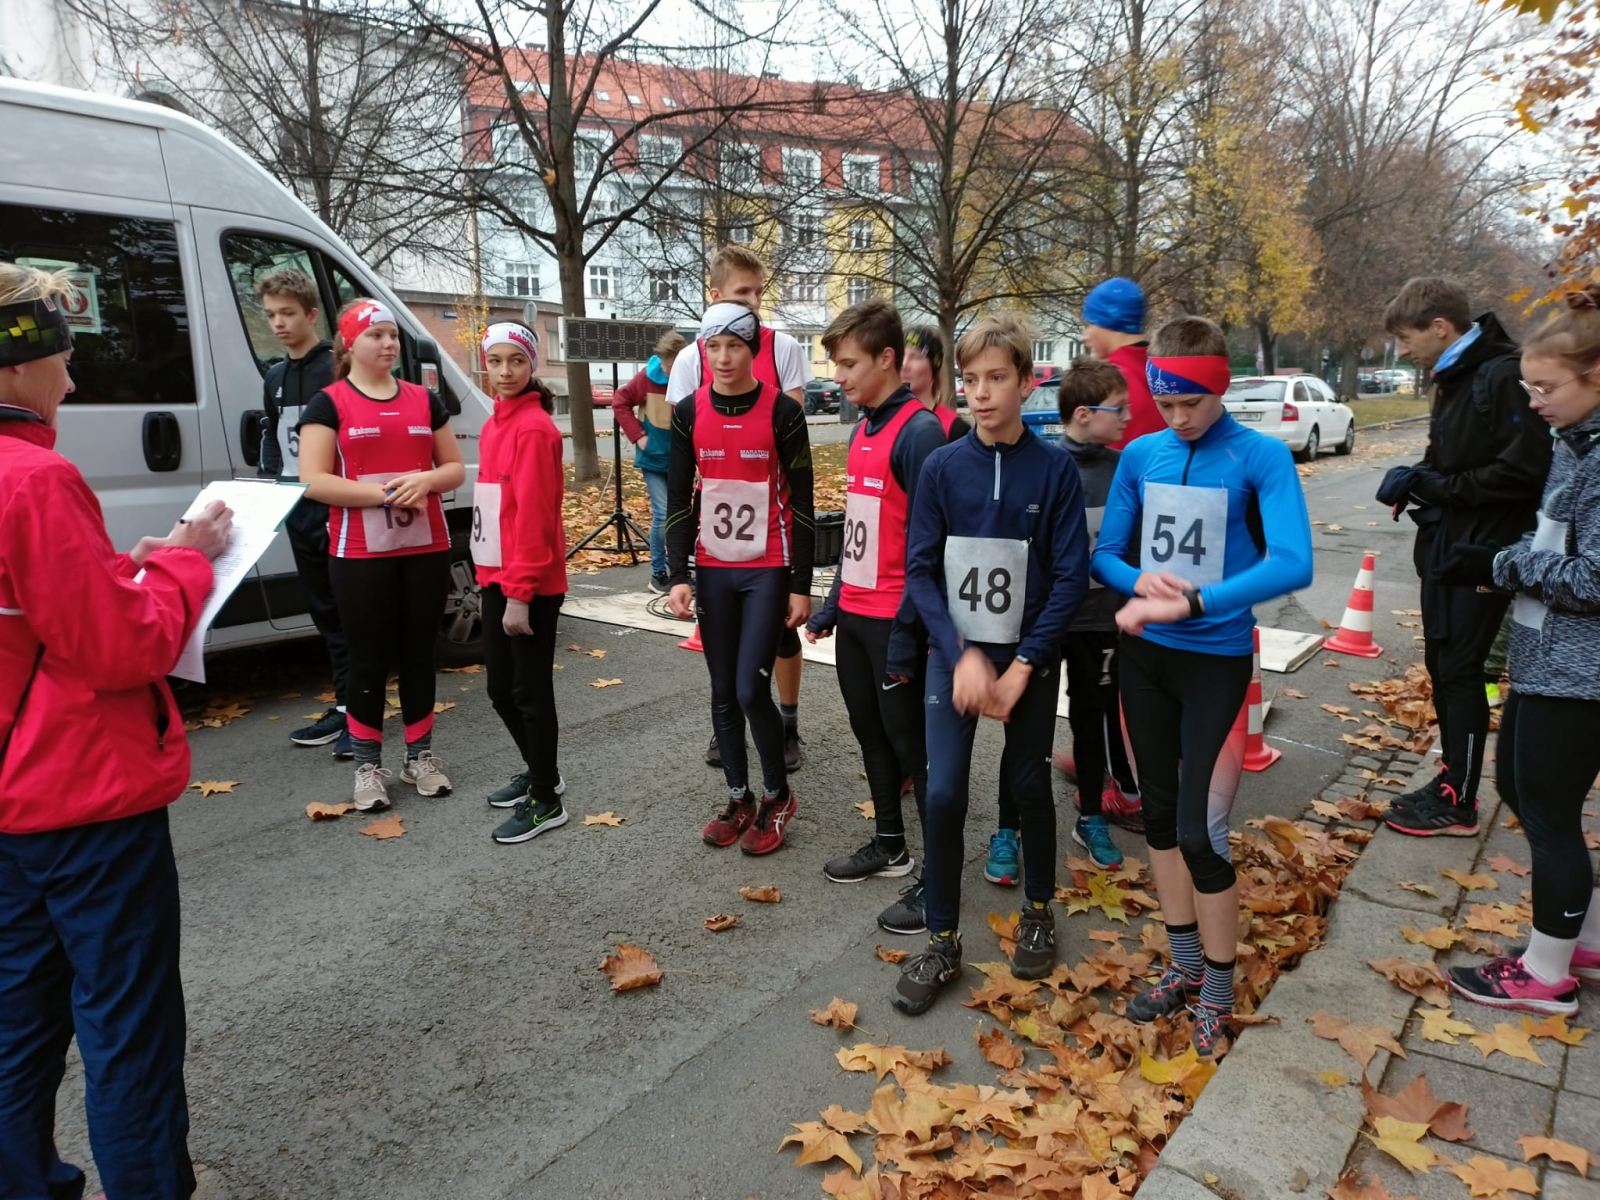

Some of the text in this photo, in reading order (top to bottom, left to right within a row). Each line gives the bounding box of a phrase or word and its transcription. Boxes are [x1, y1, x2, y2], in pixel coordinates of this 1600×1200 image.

[713, 502, 756, 542] 32
[844, 518, 868, 562] 29
[1150, 514, 1207, 566] 54
[958, 566, 1012, 615] 48
[1101, 648, 1115, 673] 7
